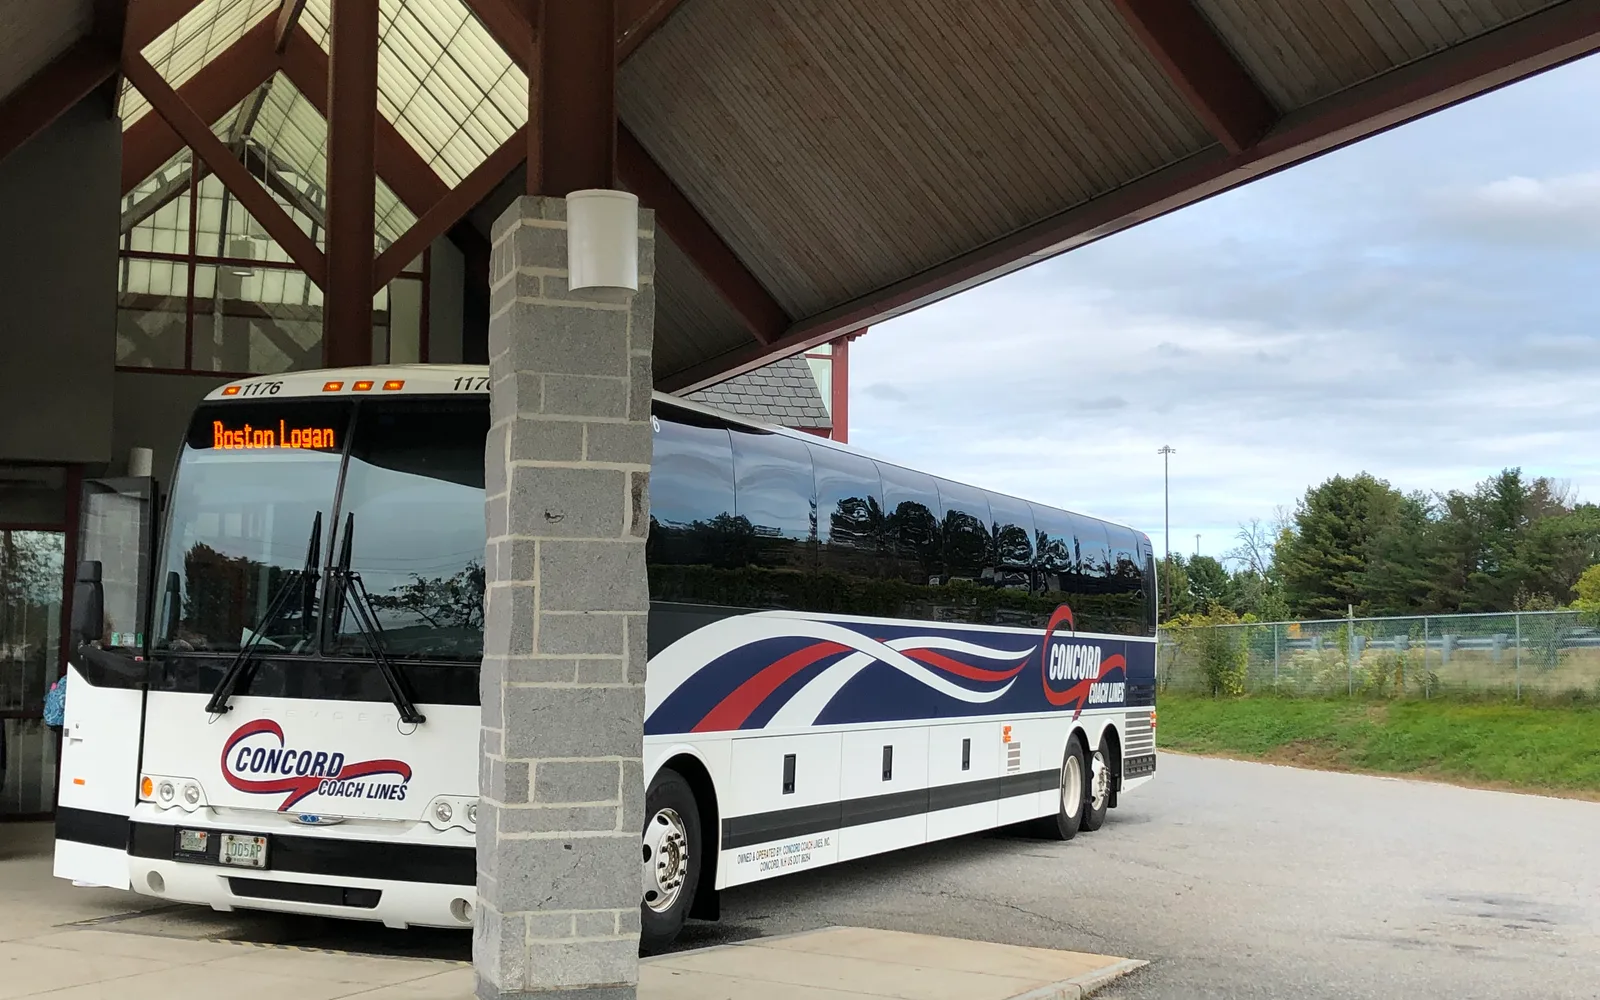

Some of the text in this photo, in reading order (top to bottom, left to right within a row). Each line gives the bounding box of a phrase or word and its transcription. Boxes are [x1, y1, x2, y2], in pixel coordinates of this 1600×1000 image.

[243, 381, 283, 396] 1176
[213, 419, 335, 450] Boston Logan
[1049, 643, 1102, 681] CONCORD
[1088, 682, 1125, 704] COACH LINES
[235, 746, 345, 778] CONCORD
[318, 780, 407, 801] COACH LINES
[756, 848, 777, 861] OPERATED
[783, 843, 801, 855] CONCORD
[801, 840, 813, 851] COACH
